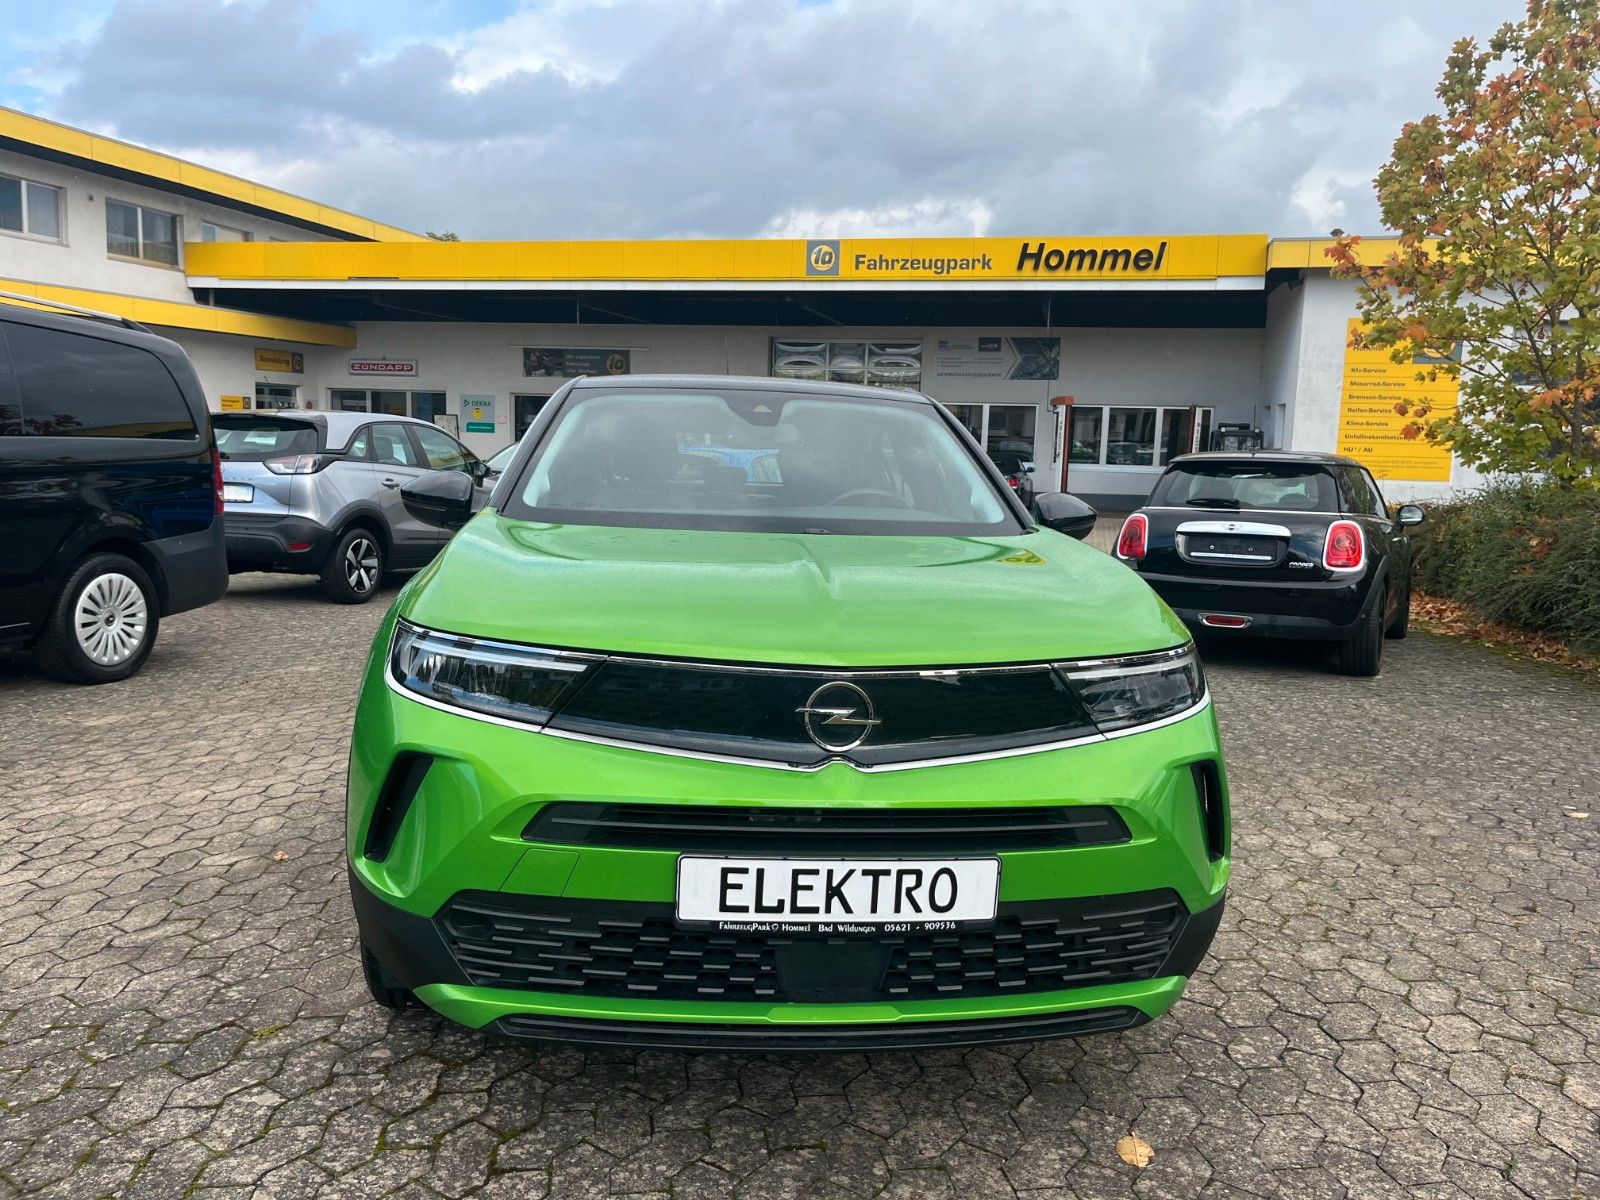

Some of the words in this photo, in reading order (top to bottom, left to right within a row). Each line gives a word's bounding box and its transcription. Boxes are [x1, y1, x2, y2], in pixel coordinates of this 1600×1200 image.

[811, 246, 834, 267] 1a
[854, 253, 993, 276] Fahrzeugpark
[1016, 241, 1167, 273] Hommel
[352, 362, 412, 372] ZÜNDAPP
[717, 866, 959, 915] ELEKTRO
[818, 923, 833, 933] Bad
[836, 923, 876, 934] Wildungen
[883, 923, 911, 933] 05621
[924, 920, 957, 932] 909536
